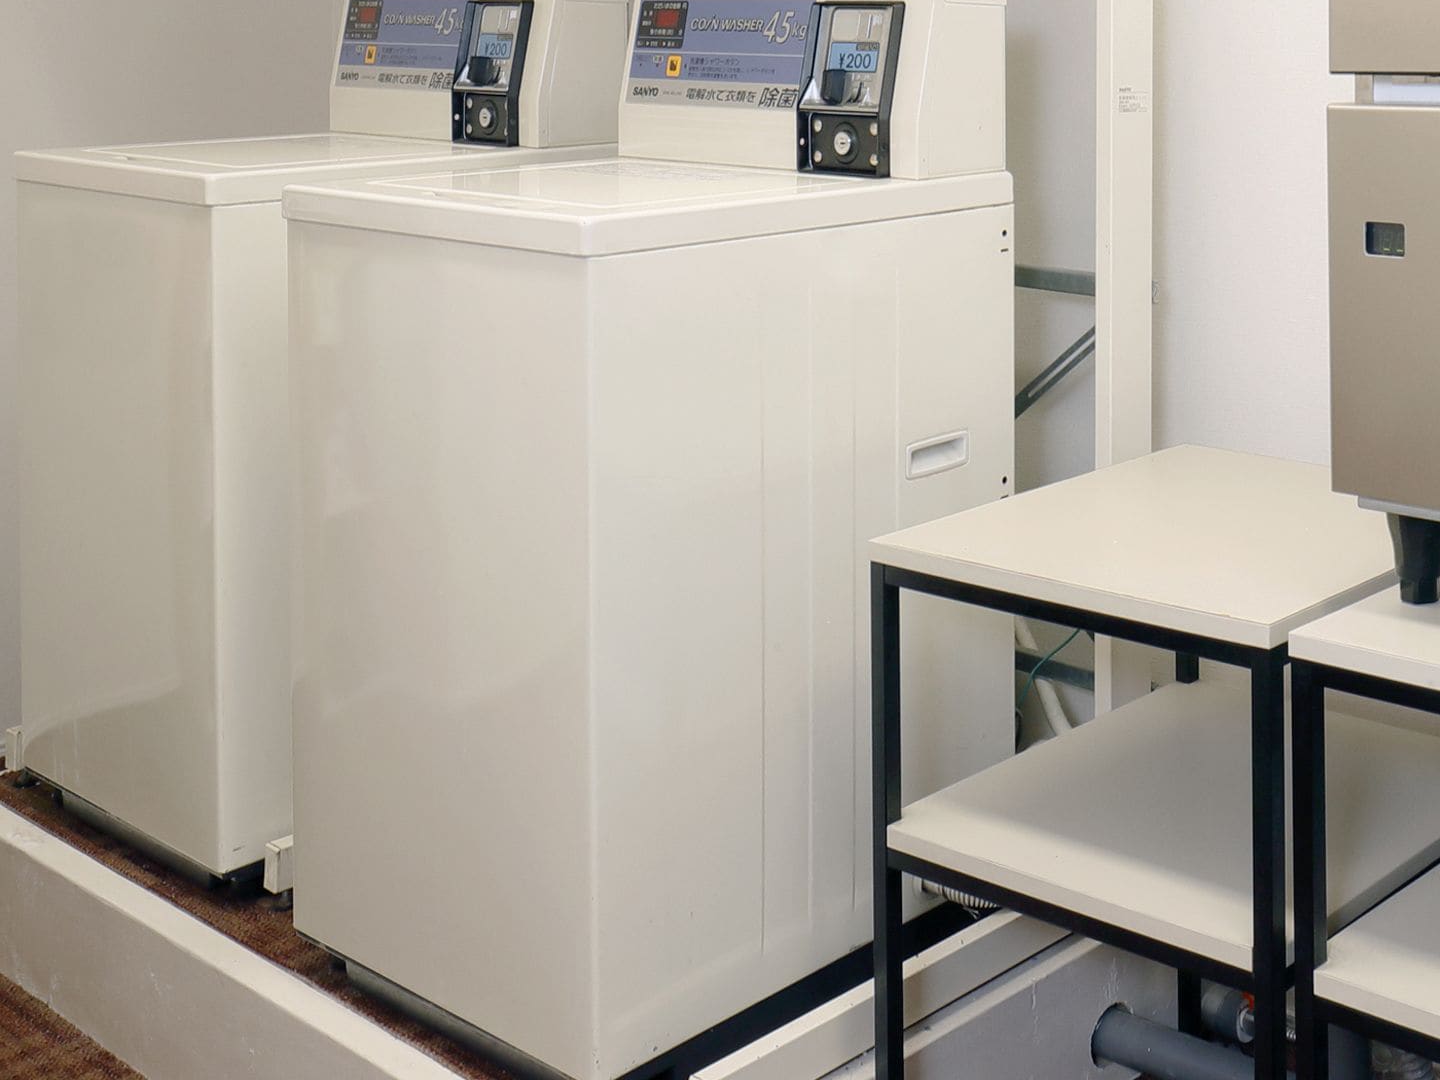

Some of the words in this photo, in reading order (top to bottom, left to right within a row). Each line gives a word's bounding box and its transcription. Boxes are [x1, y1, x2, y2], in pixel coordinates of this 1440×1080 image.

[404, 15, 435, 26] WASHER
[690, 15, 720, 31] COIN
[721, 19, 764, 32] WASHER
[484, 41, 508, 57] ¥200
[839, 52, 872, 69] ¥200
[340, 71, 359, 81] SANYO
[632, 86, 659, 98] SANYO
[686, 88, 757, 104] 電解水で衣類を
[758, 87, 799, 109] 除菌
